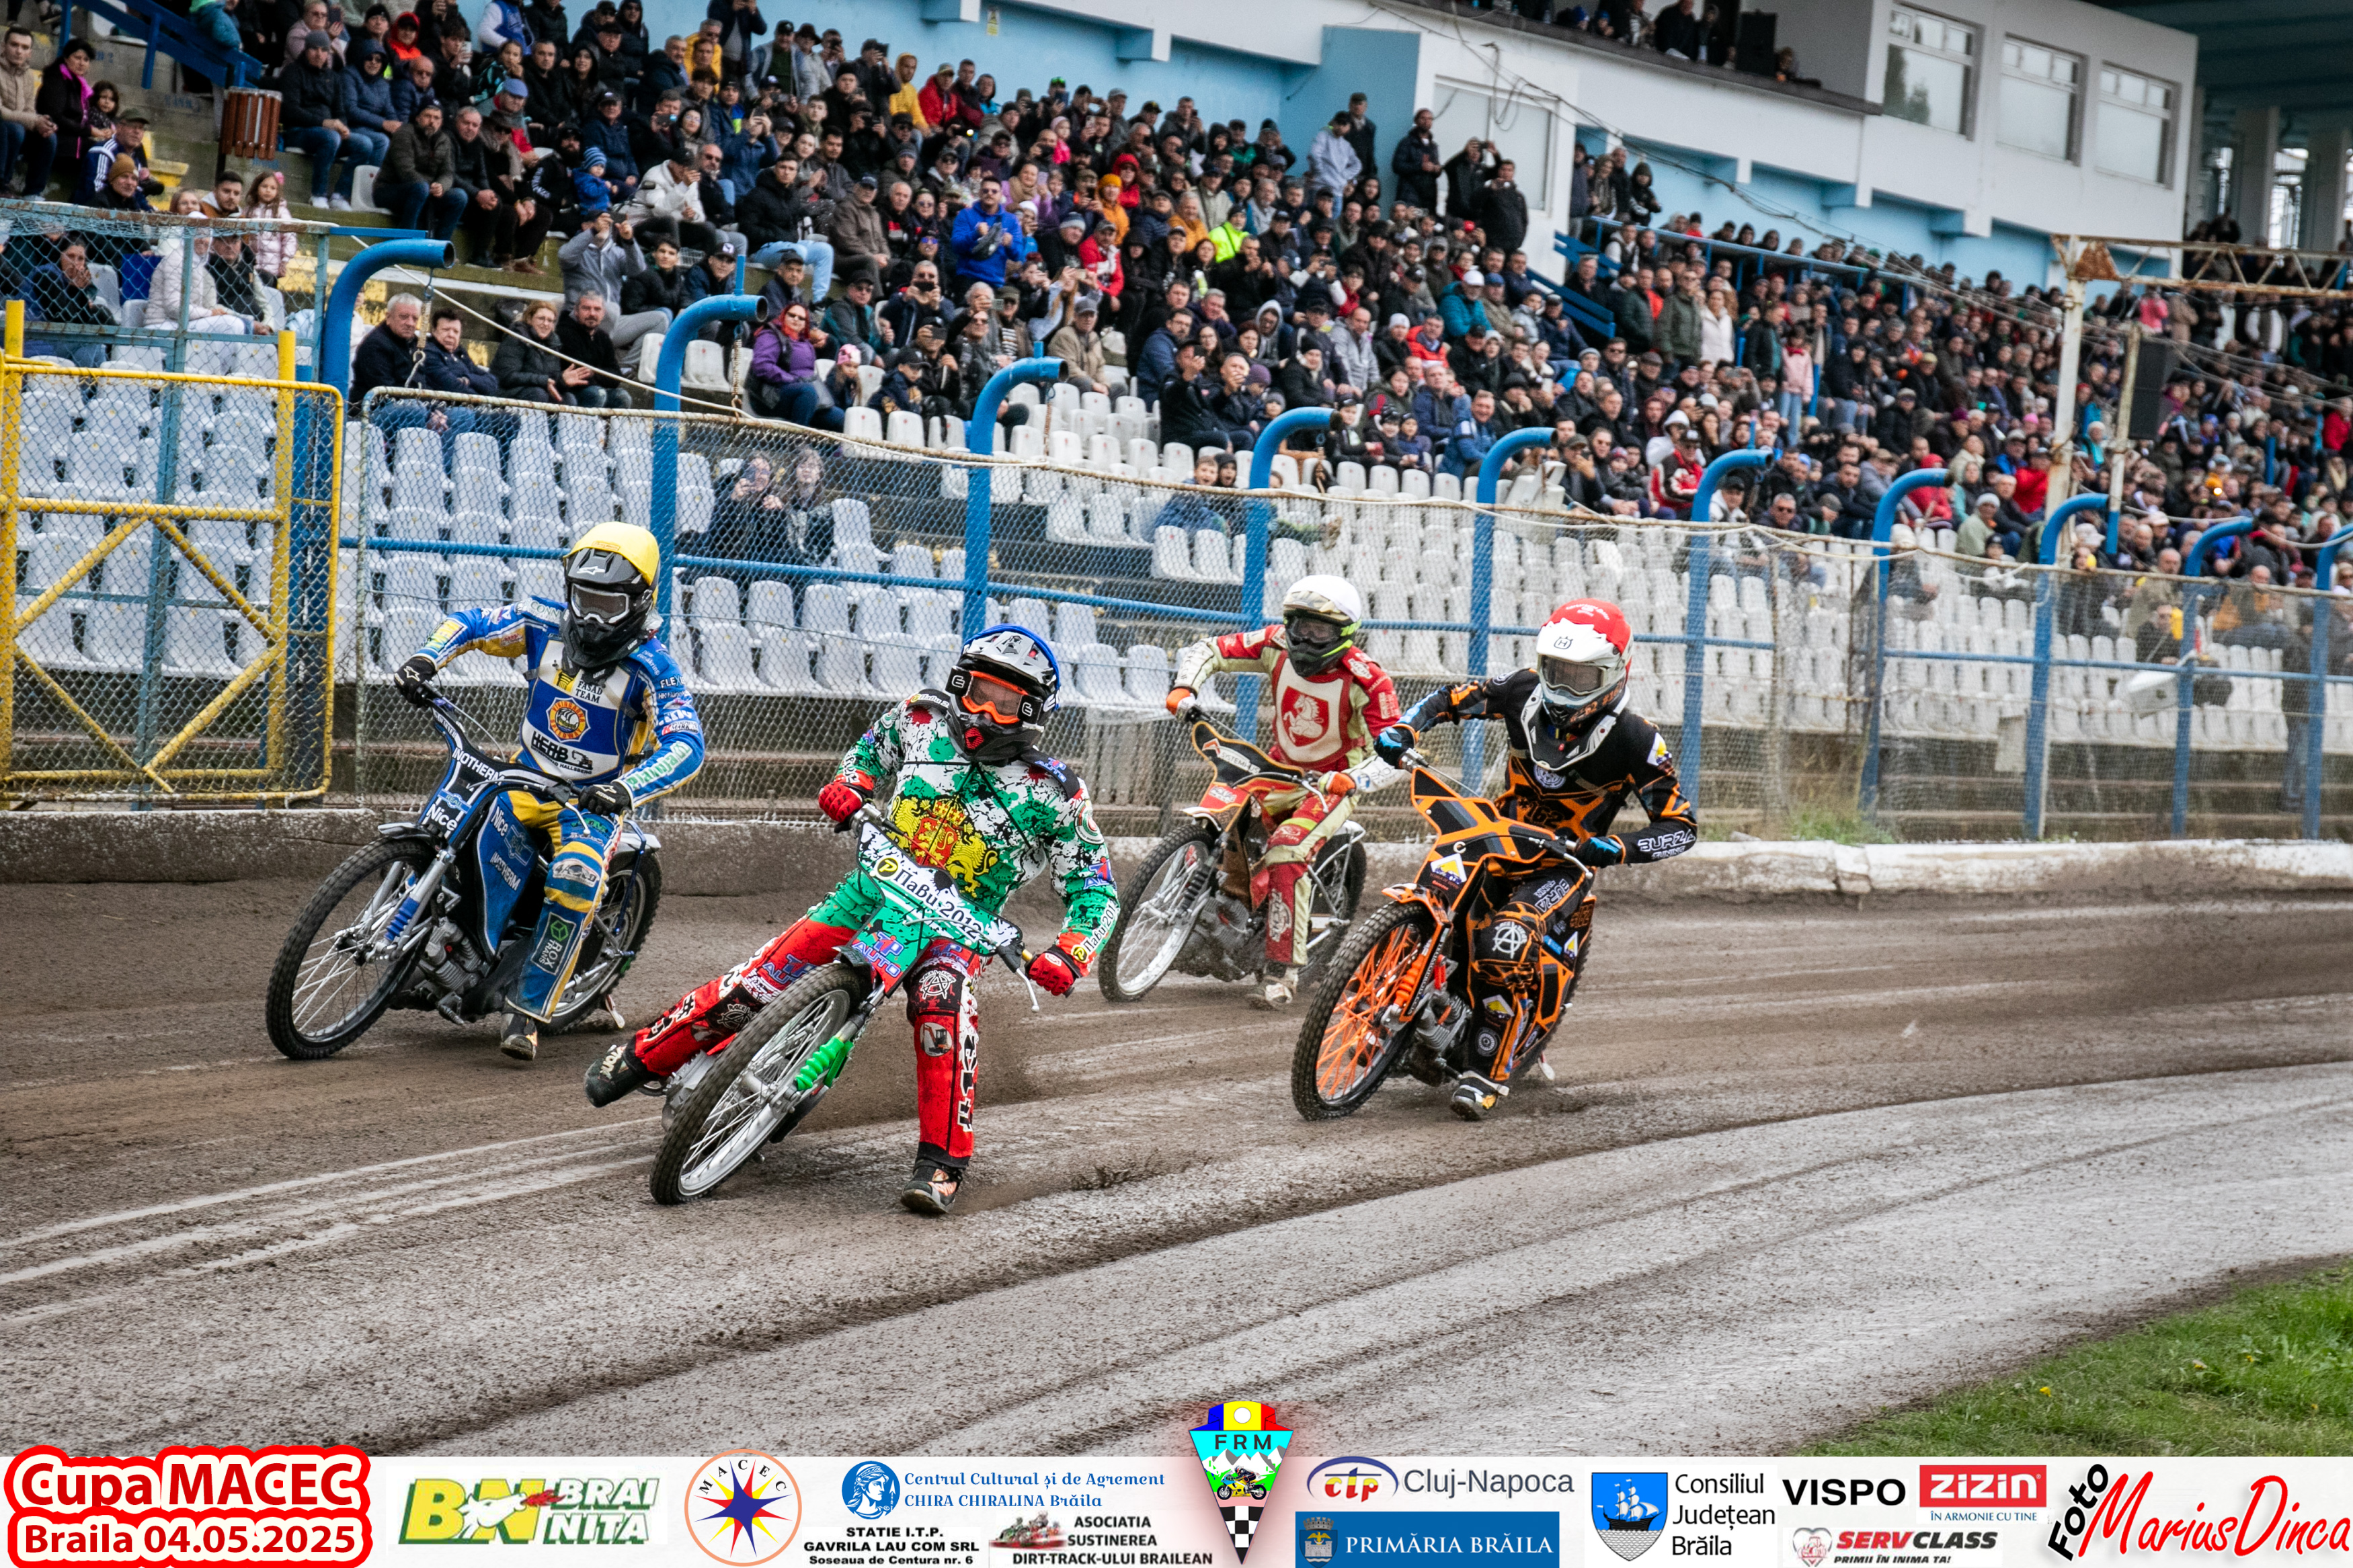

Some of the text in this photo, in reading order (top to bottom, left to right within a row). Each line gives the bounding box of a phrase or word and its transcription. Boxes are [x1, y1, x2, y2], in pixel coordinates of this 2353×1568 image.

[575, 689, 601, 704] TEAM
[577, 680, 603, 695] FASAD
[530, 731, 569, 761] HEAB
[452, 746, 506, 786] INOTHERM
[426, 803, 458, 832] Nice
[490, 806, 509, 837] Nice
[489, 851, 522, 891] INOTHERM
[939, 900, 982, 941] 2012
[539, 939, 555, 964] TRANS
[544, 941, 563, 968] ROX
[851, 941, 902, 978] AUTO
